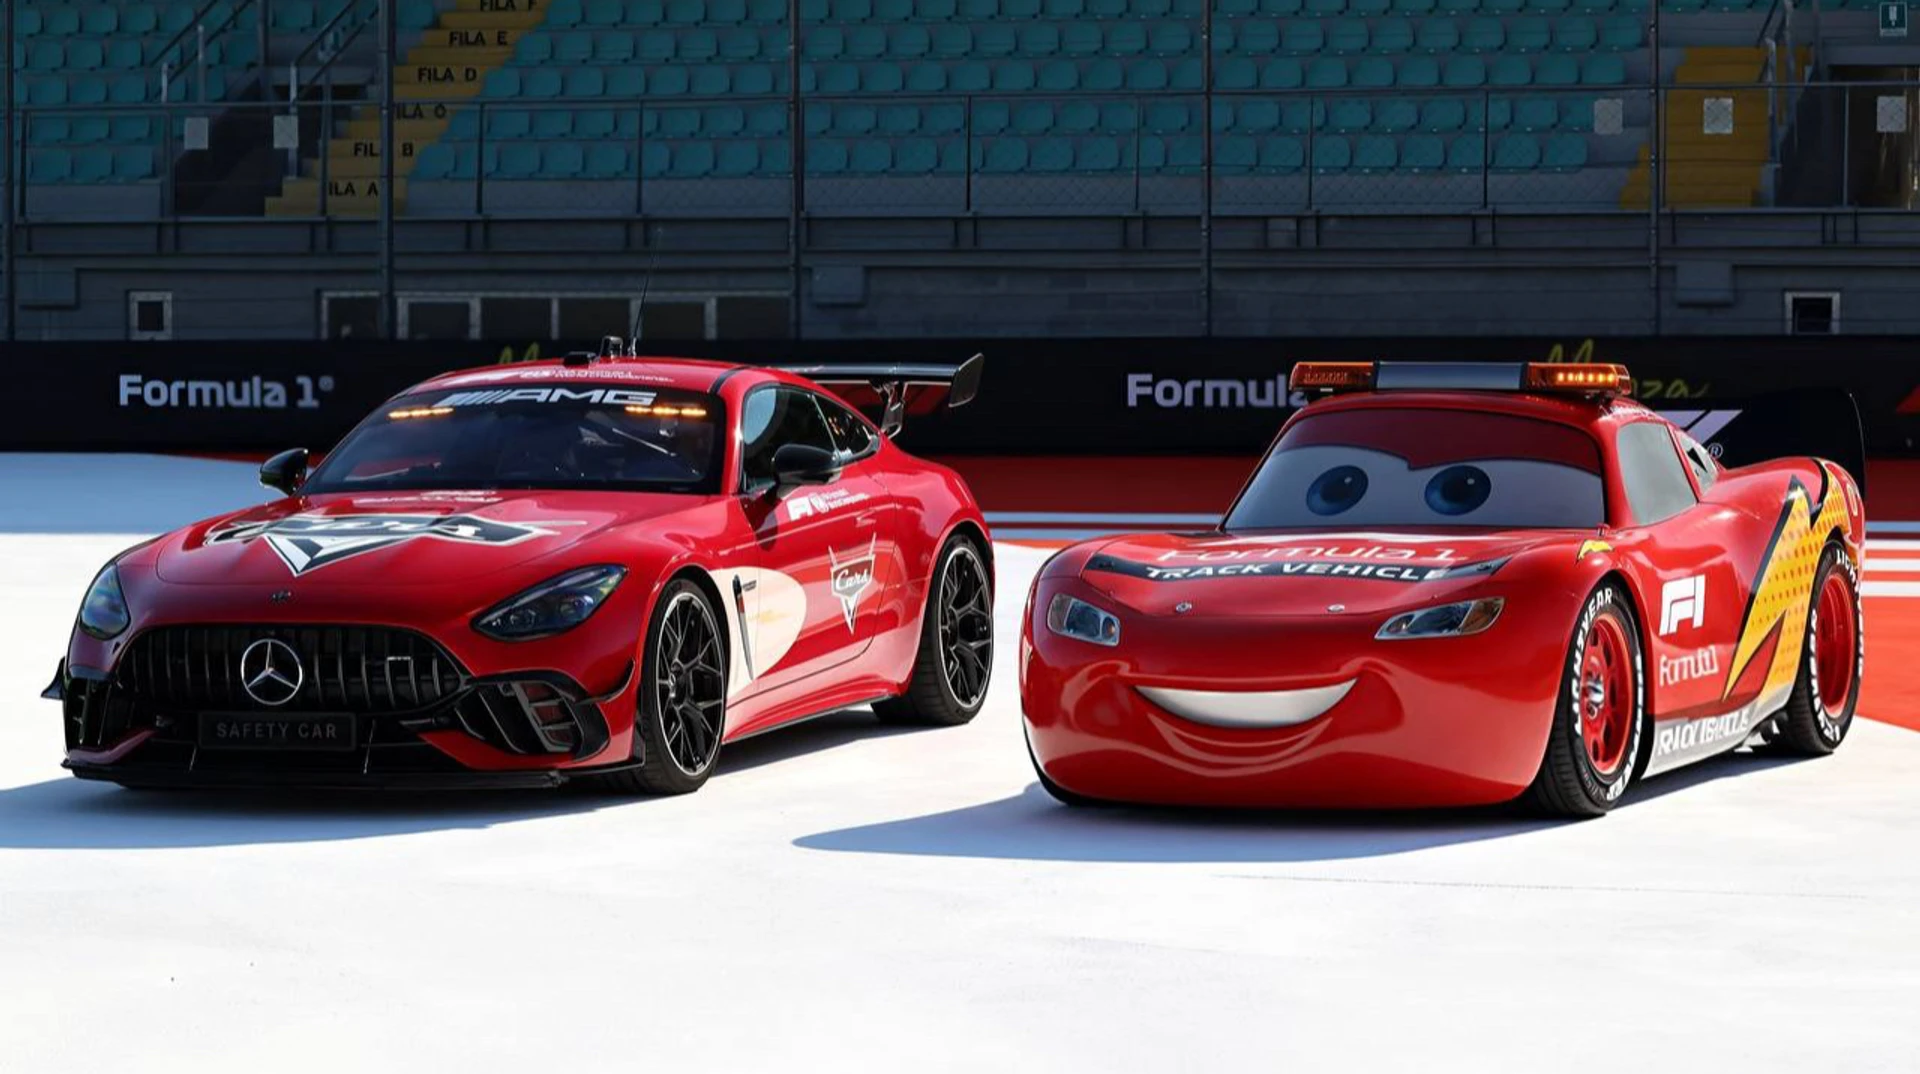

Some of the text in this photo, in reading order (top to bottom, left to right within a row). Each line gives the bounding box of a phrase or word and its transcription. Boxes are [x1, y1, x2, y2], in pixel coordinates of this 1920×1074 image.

[480, 0, 516, 11] FILA
[448, 31, 508, 46] FILA E
[417, 67, 477, 82] FILA D
[396, 104, 423, 119] ILA
[354, 143, 414, 157] FIL B
[328, 182, 379, 196] ILA A
[119, 374, 287, 408] Formula
[498, 388, 658, 407] AMG
[835, 568, 870, 591] Cars
[1146, 563, 1451, 582] TRACK VEHICLE
[217, 722, 338, 738] SAFETY CAR
